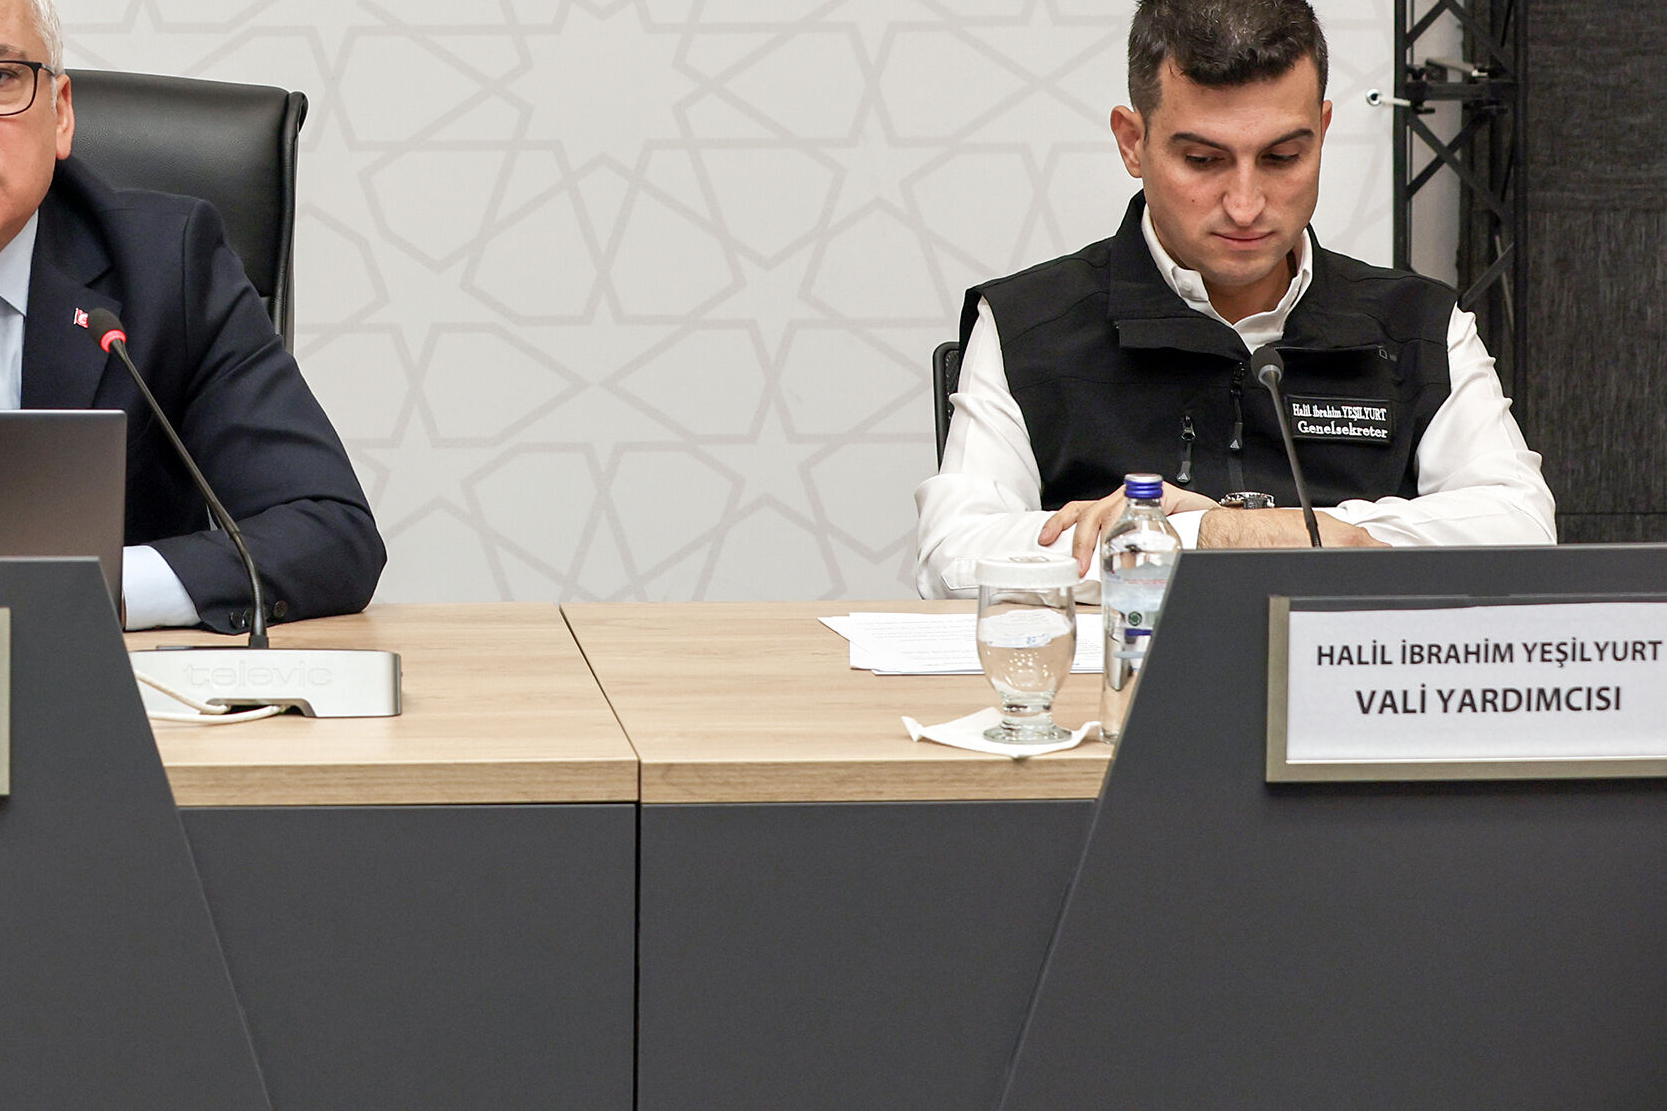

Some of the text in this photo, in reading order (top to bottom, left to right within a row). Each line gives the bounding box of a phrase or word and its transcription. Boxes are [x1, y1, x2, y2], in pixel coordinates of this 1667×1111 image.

[1292, 403, 1312, 417] Halil
[1297, 420, 1388, 439] Genelsekreter
[1316, 637, 1663, 668] HALİL İBRAHİM YEŞİLYURT
[183, 660, 333, 690] televic
[1355, 683, 1622, 715] VALİ YARDIMCISI
